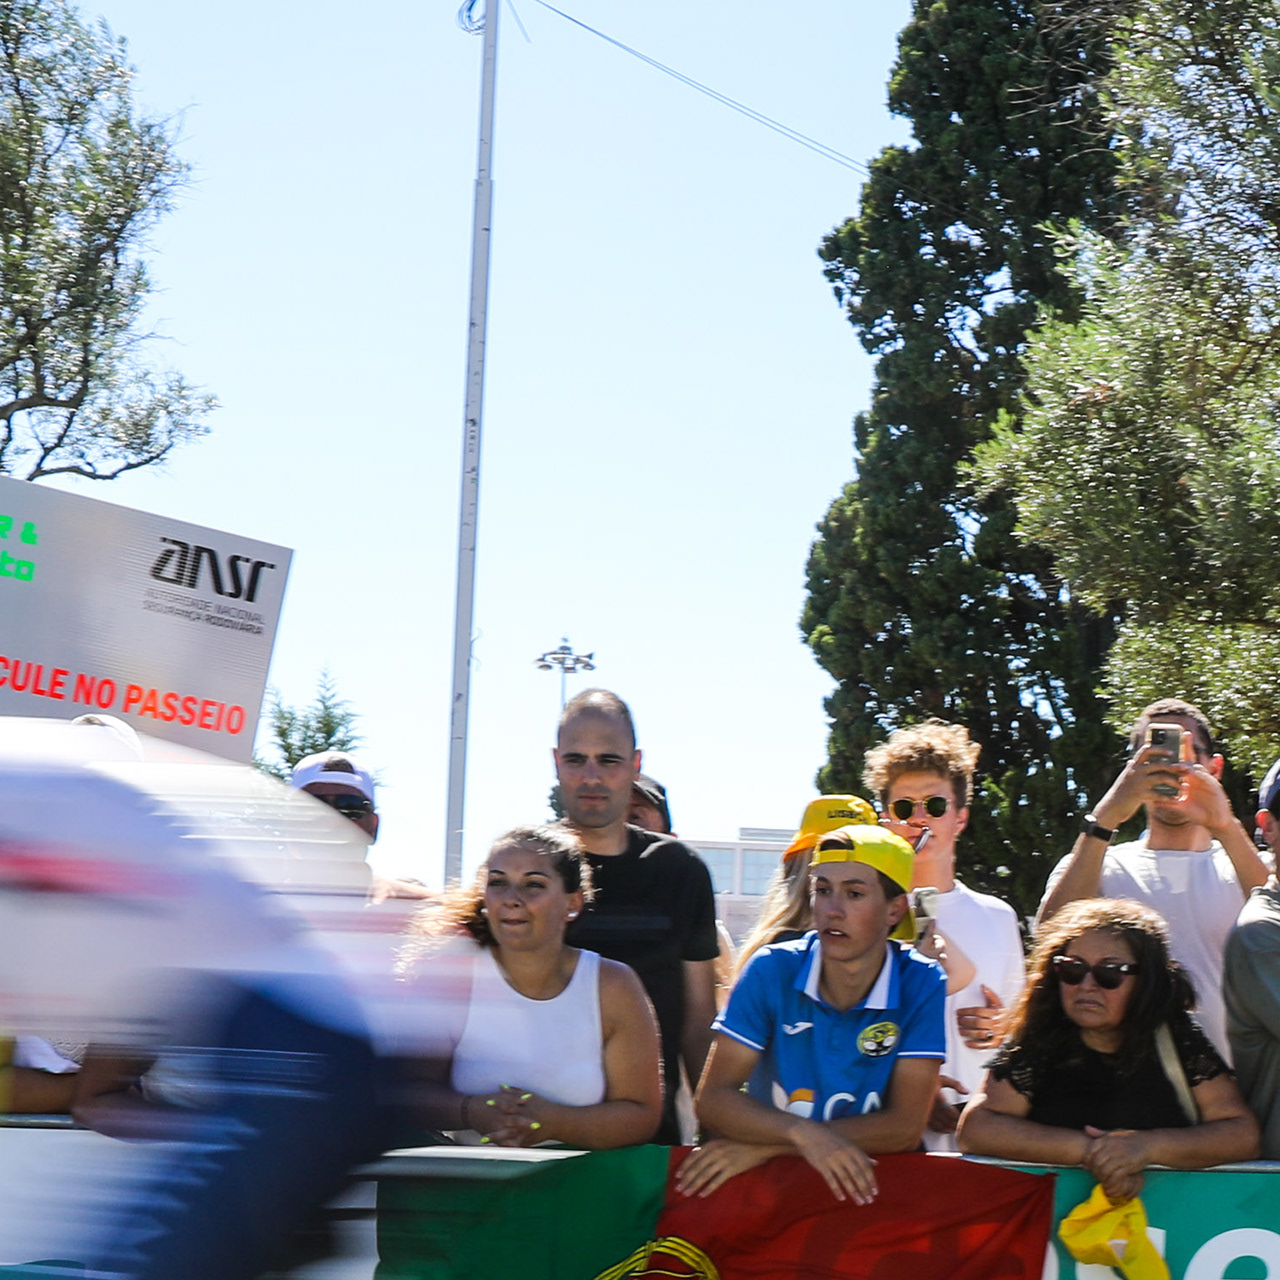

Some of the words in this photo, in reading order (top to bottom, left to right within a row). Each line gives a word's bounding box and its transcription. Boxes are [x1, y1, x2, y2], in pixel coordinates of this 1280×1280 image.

[20, 521, 38, 545] &
[72, 672, 118, 709] NO
[122, 683, 246, 735] PASSEIO
